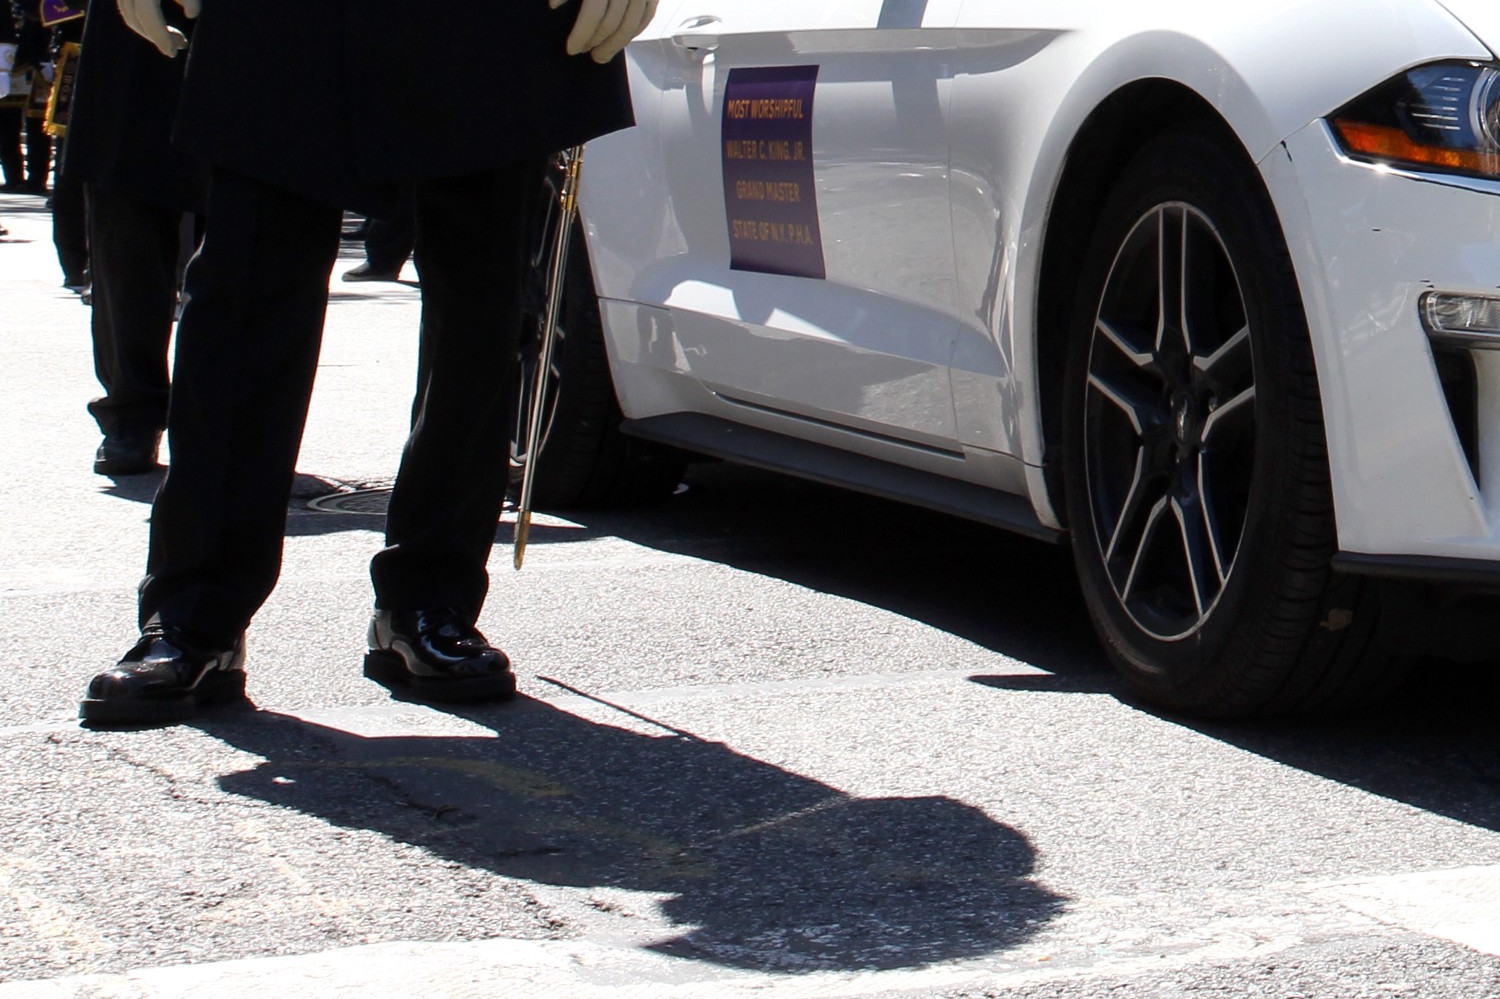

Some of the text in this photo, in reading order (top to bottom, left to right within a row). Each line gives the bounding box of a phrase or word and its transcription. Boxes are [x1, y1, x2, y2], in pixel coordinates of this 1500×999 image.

[728, 99, 803, 119] MOST WORSHIPFUL
[727, 140, 757, 159] WALTER
[759, 140, 768, 161] C.
[736, 180, 801, 203] GRAND MASTER
[732, 219, 758, 240] STATE
[759, 220, 770, 242] OF
